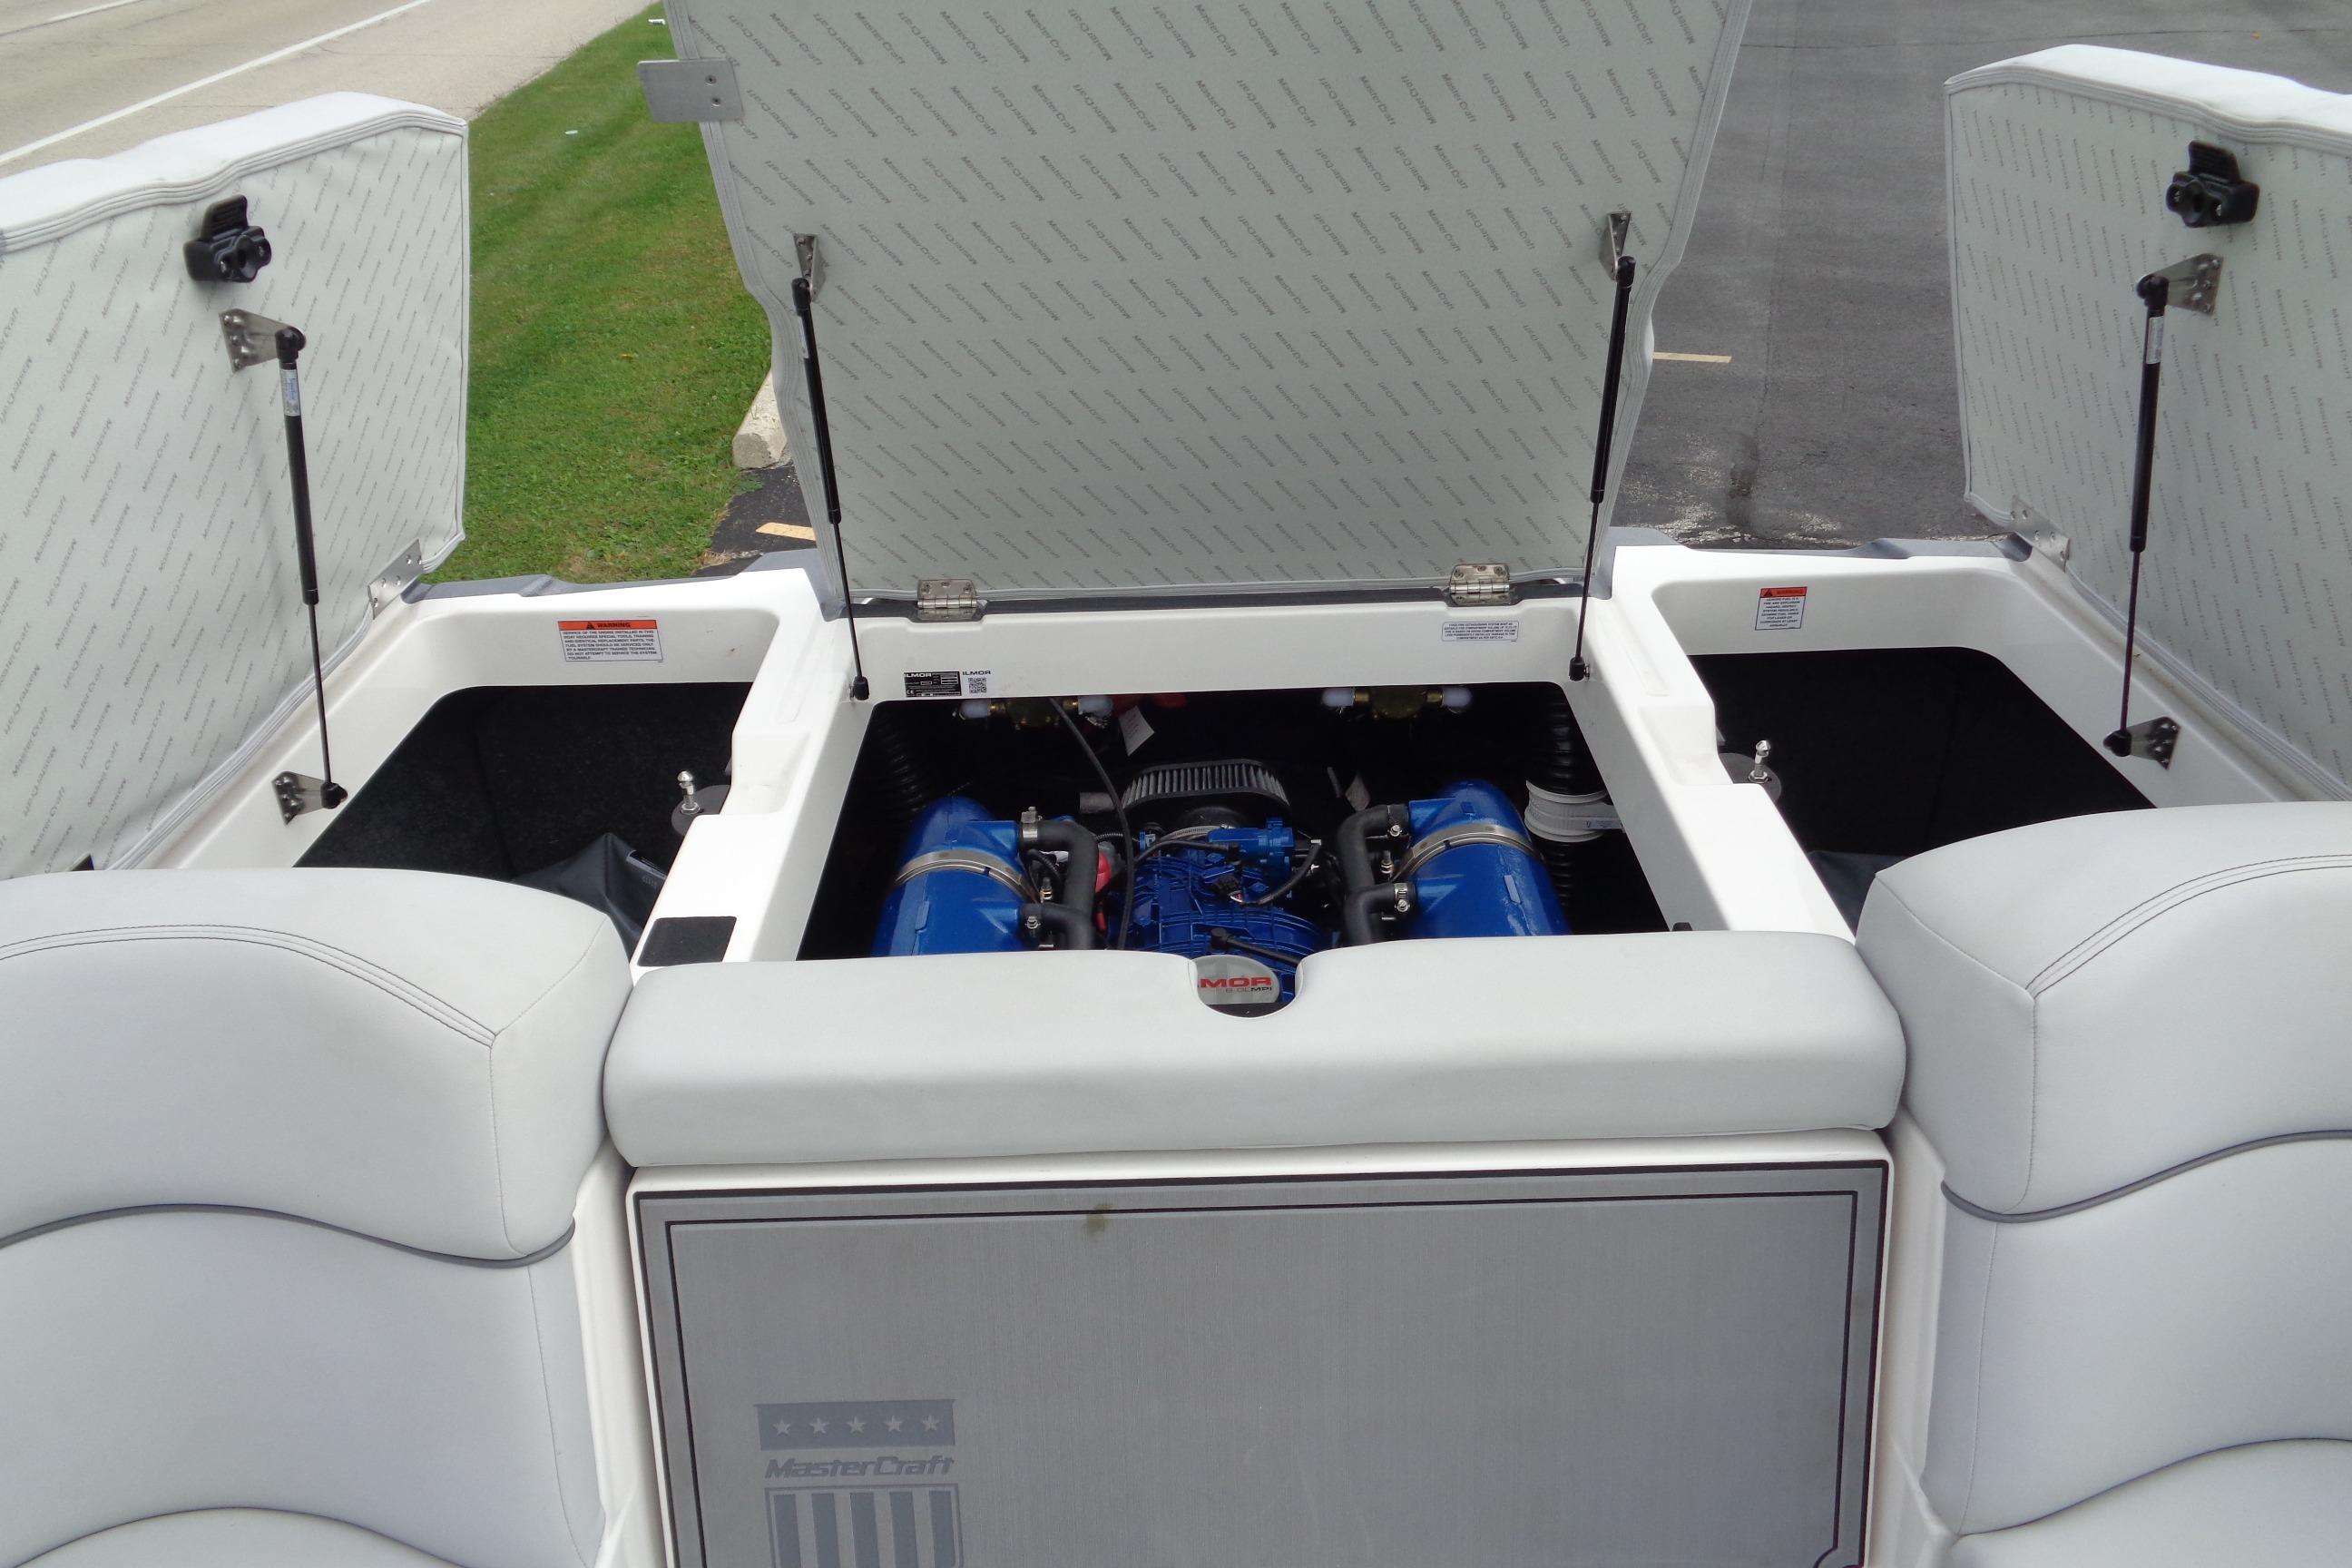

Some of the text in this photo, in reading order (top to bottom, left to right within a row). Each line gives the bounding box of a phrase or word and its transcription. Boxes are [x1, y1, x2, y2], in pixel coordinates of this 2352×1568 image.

[728, 15, 782, 67] MasterCraft
[769, 13, 823, 65] MasterCraft
[813, 13, 865, 65] MasterCraft
[854, 12, 906, 64] MasterCraft
[897, 12, 948, 64] MasterCraft
[940, 11, 988, 64] MasterCraft
[983, 11, 1030, 64] MasterCraft
[1024, 9, 1072, 62] MasterCraft
[1068, 8, 1113, 61] MasterCraft
[1110, 6, 1154, 59] MasterCraft
[1152, 6, 1197, 59] MasterCraft
[747, 89, 799, 139] MasterCraft
[787, 88, 838, 138] MasterCraft
[828, 88, 878, 138] MasterCraft
[868, 86, 918, 137] MasterCraft
[909, 87, 958, 137] MasterCraft
[950, 85, 997, 135] MasterCraft
[992, 86, 1037, 135] MasterCraft
[1032, 84, 1076, 133] MasterCraft
[1073, 84, 1118, 133] MasterCraft
[1113, 82, 1157, 132] MasterCraft
[1155, 82, 1197, 132] MasterCraft
[1195, 80, 1237, 130] MasterCraft
[1237, 80, 1277, 130] MasterCraft
[1278, 77, 1317, 127] MasterCraft
[1318, 78, 1357, 127] MasterCraft
[1359, 75, 1396, 125] MasterCraft
[1401, 75, 1437, 124] MasterCraft
[1441, 74, 1476, 122] MasterCraft
[1483, 73, 1517, 122] MasterCraft
[1523, 71, 1556, 120] MasterCraft
[1564, 70, 1597, 120] MasterCraft
[1606, 68, 1637, 118] MasterCraft
[1647, 67, 1677, 117] MasterCraft
[764, 161, 815, 206] MasterCraft
[804, 159, 852, 203] MasterCraft
[882, 157, 929, 203] MasterCraft
[960, 156, 1006, 201] MasterCraft
[1039, 155, 1083, 201] MasterCraft
[1118, 152, 1160, 198] MasterCraft
[1196, 151, 1237, 196] MasterCraft
[1315, 148, 1353, 193] MasterCraft
[1354, 146, 1391, 192] MasterCraft
[1433, 144, 1468, 189] MasterCraft
[1552, 141, 1584, 186] MasterCraft
[1591, 139, 1622, 183] MasterCraft
[971, 221, 1015, 264] MasterCraft
[1237, 215, 1276, 259] MasterCraft
[1542, 206, 1573, 248] MasterCraft
[872, 285, 917, 324] MasterCraft
[1165, 278, 1204, 318] MasterCraft
[1458, 270, 1490, 309] MasterCraft
[1198, 977, 1272, 987] MOR
[765, 1455, 955, 1478] MasterCraft
